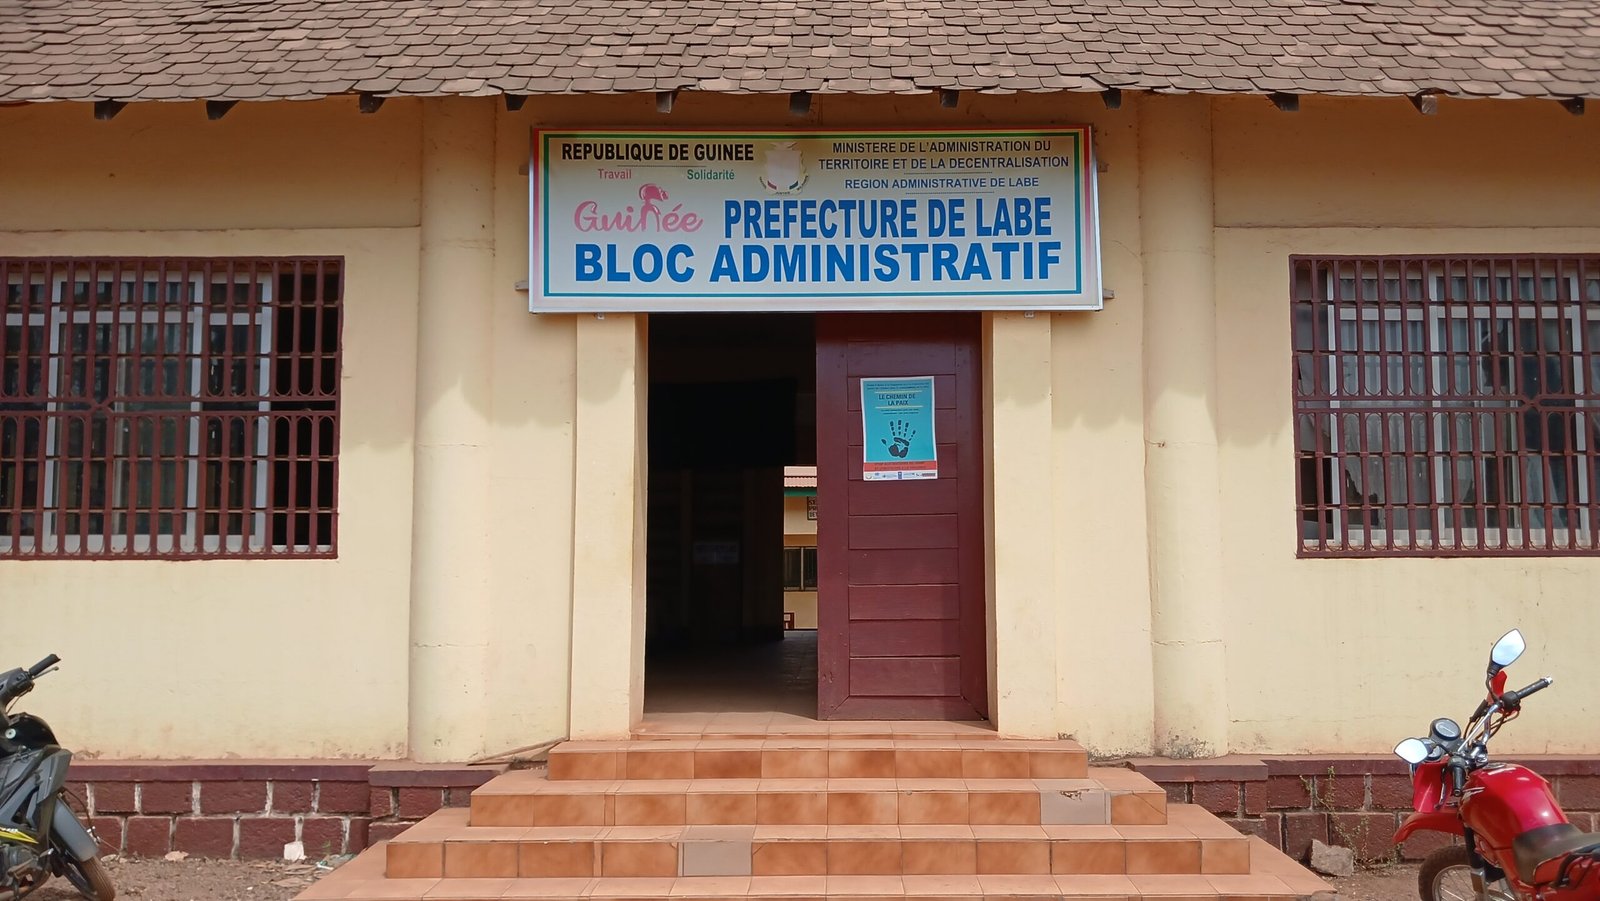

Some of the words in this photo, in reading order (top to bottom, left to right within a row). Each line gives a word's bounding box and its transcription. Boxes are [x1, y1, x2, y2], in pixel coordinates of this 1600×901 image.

[562, 143, 664, 160] REPUBLIQUE
[669, 144, 689, 160] DE
[694, 143, 754, 160] GUINEE
[832, 142, 896, 153] MINISTERE
[900, 142, 916, 152] DE
[1034, 140, 1051, 151] DU
[819, 159, 889, 170] TERRITOIRE
[893, 158, 907, 169] ET
[911, 158, 927, 169] DE
[930, 158, 945, 169] LA
[949, 156, 1069, 168] DECENTRALISATION
[598, 168, 632, 180] Travail
[687, 168, 735, 180] Solidarité
[845, 179, 889, 189] REGION
[892, 178, 987, 189] ADMINISTRATIVE
[990, 178, 1005, 188] DE
[1008, 177, 1039, 188] LABE
[574, 200, 703, 232] Guinée
[725, 199, 918, 239] PREFECTURE
[928, 198, 966, 238] DE
[976, 197, 1052, 237] LABE
[575, 244, 695, 282] BLOC
[709, 242, 1061, 282] ADMINISTRATIF
